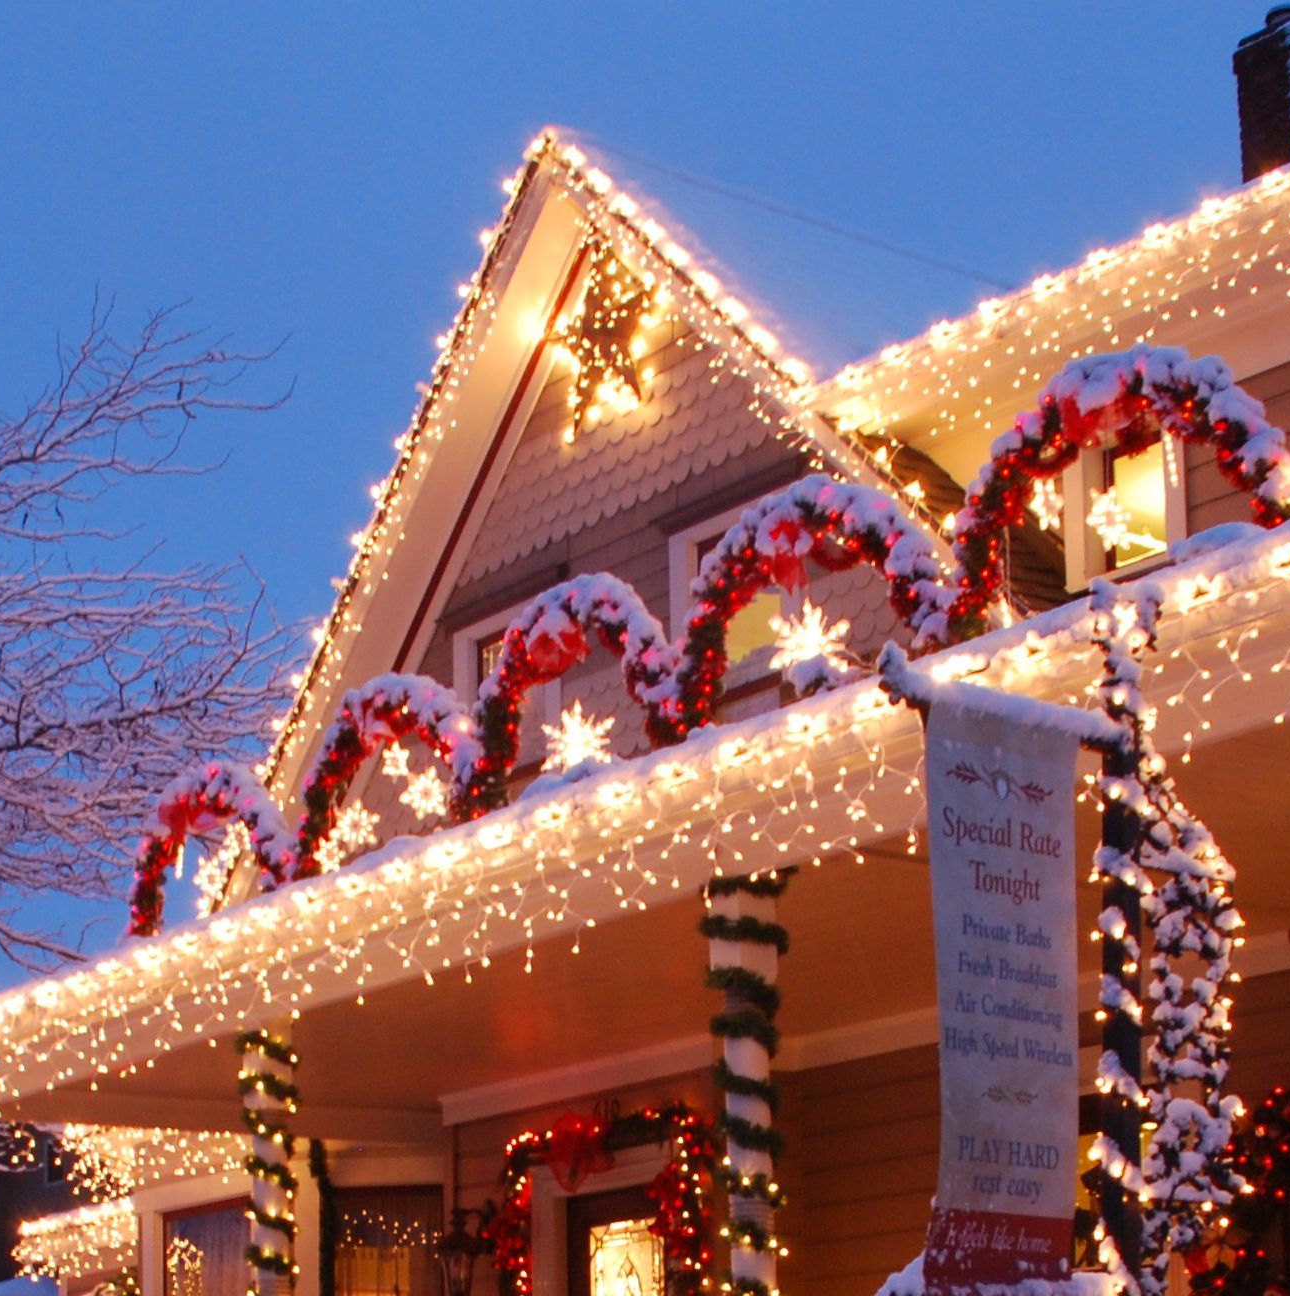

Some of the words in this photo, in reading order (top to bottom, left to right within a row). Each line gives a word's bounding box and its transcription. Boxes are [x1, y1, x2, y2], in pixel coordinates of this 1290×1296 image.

[942, 806, 1011, 848] Special
[1019, 822, 1061, 858] Rate
[970, 859, 1042, 906] Tonight
[962, 914, 1011, 943] Private
[1016, 922, 1051, 950] Baths
[958, 951, 995, 978] Fresh
[998, 957, 1058, 990] Breakfast
[954, 990, 976, 1013] Air
[981, 993, 1063, 1033] Conditioning
[944, 1026, 977, 1057] High
[983, 1031, 1019, 1062] Speed
[1023, 1037, 1073, 1067] Wireless
[957, 1135, 1003, 1165] PLAY
[1008, 1139, 1060, 1171] HARD
[972, 1170, 1002, 1194] rest
[1006, 1178, 1044, 1206] easy
[958, 1221, 988, 1249] feels
[990, 1222, 1015, 1250] like
[1017, 1227, 1052, 1253] home
